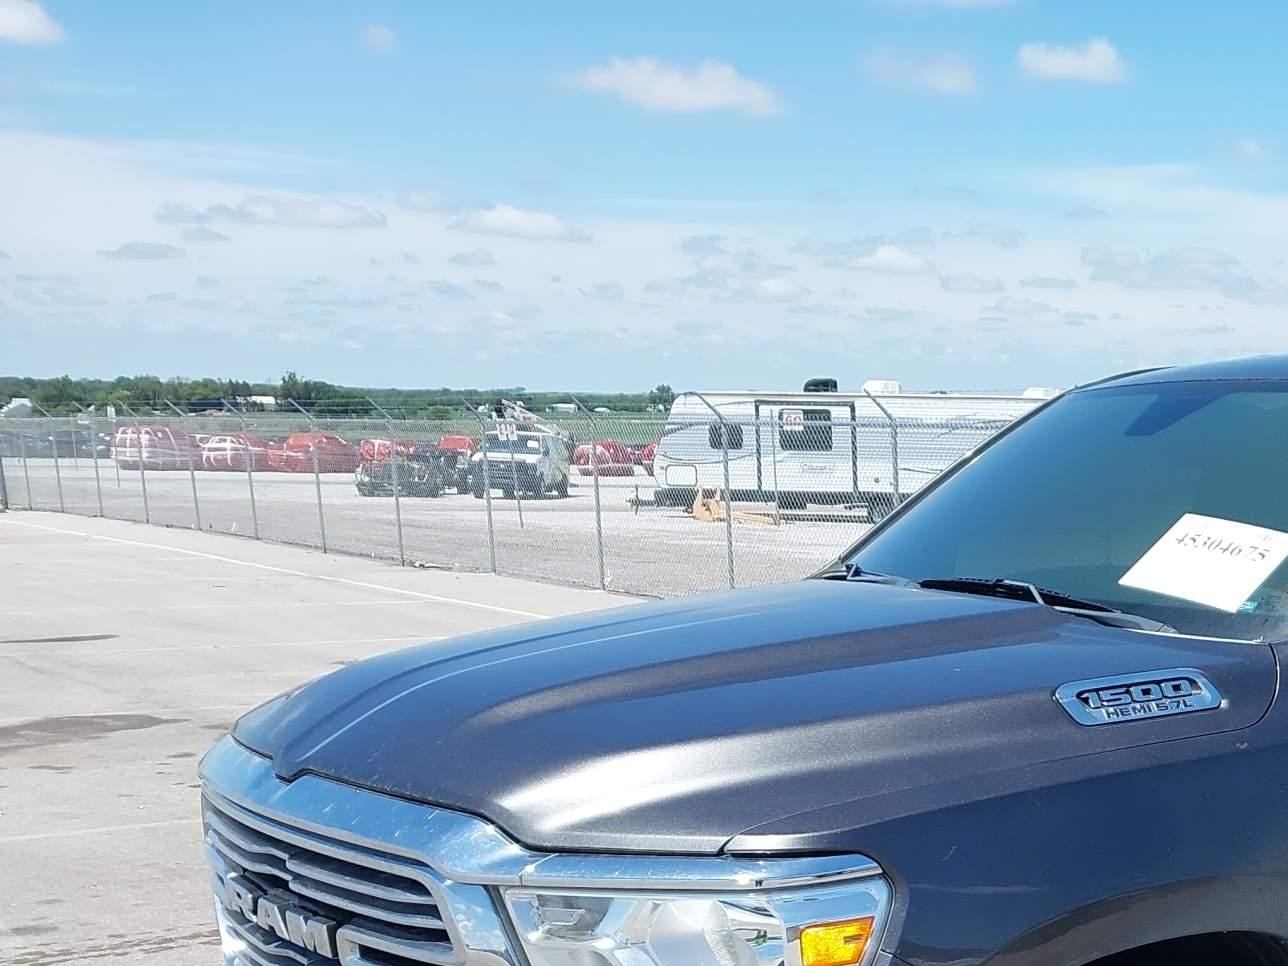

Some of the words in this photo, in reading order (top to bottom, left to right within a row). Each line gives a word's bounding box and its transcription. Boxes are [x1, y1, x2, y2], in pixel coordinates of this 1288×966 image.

[1175, 532, 1271, 562] 45304675
[1080, 679, 1194, 709] 1500
[1105, 700, 1153, 719] HEMI
[1156, 699, 1194, 712] 5.7L
[224, 876, 337, 959] RAM
